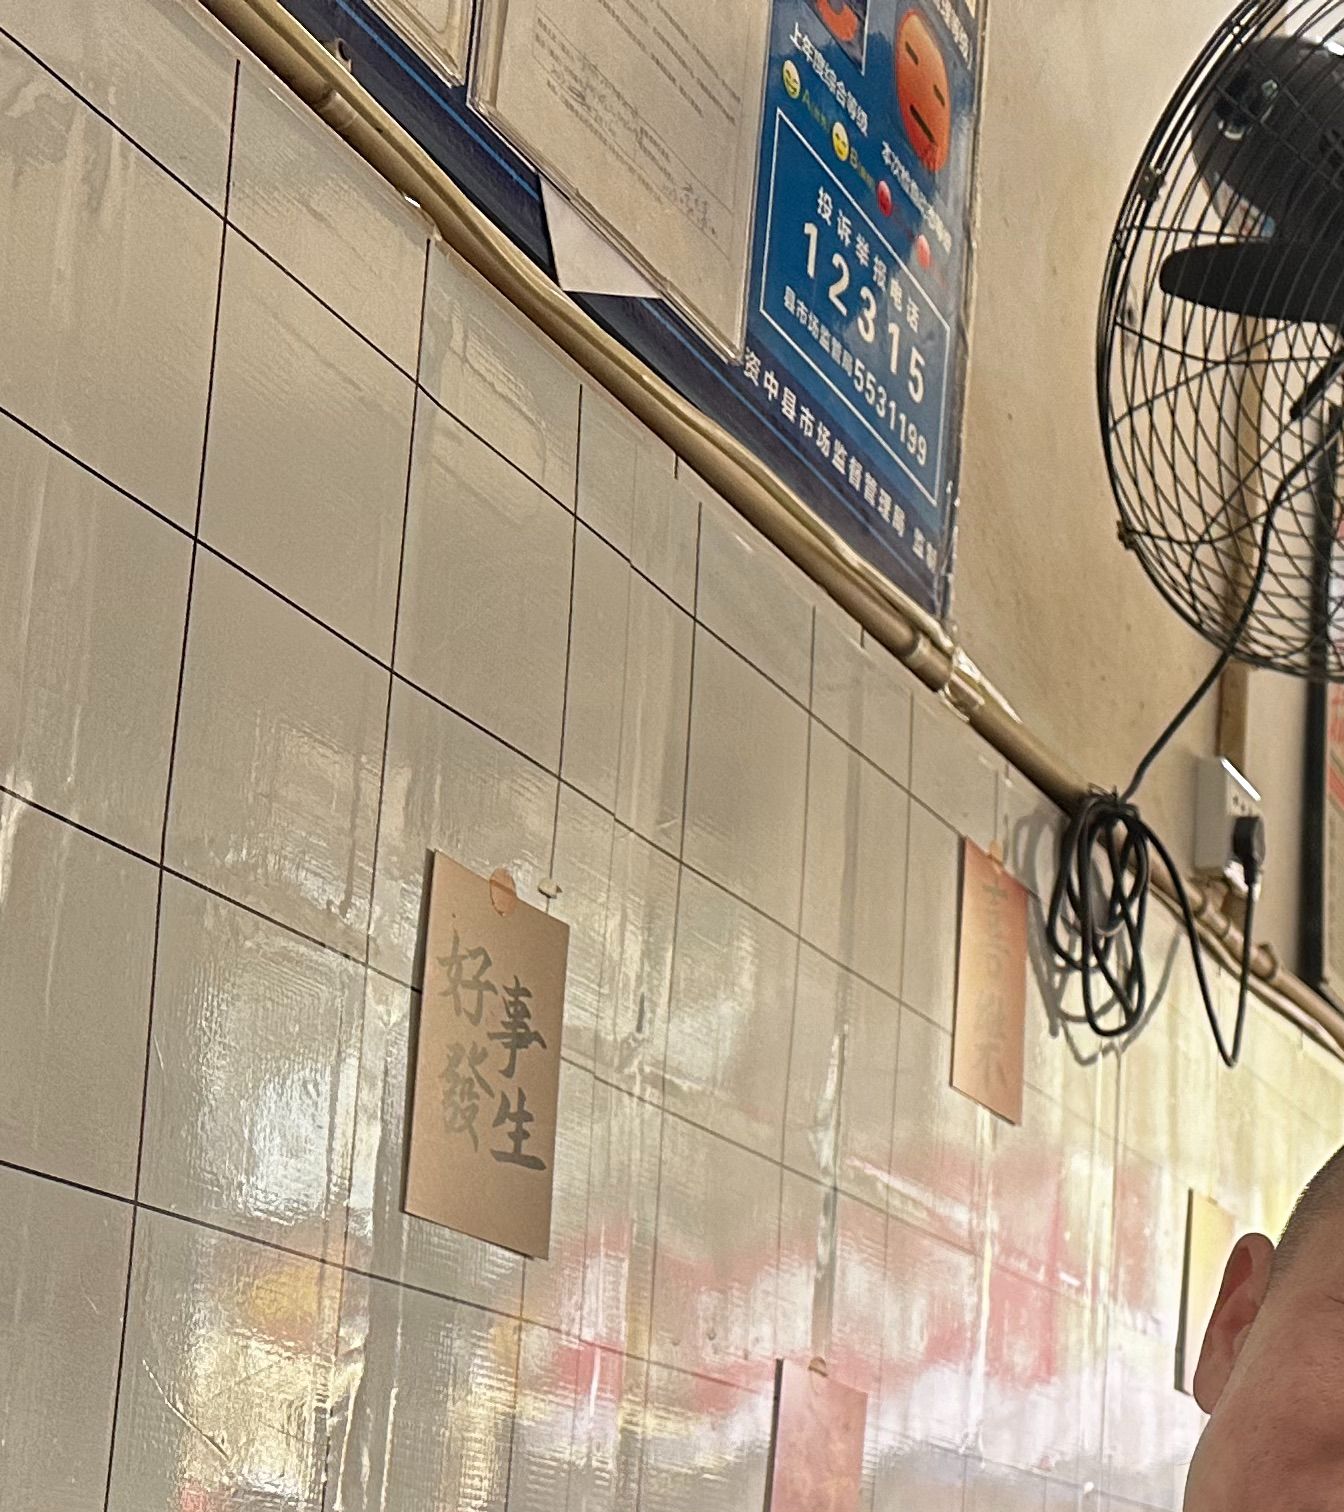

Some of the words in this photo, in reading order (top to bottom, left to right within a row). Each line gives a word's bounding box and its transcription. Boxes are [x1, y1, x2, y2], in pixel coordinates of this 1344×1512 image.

[803, 222, 928, 405] 12315
[816, 186, 920, 333] 投诉举报电话
[744, 345, 907, 538] 资中县市场监督管理局
